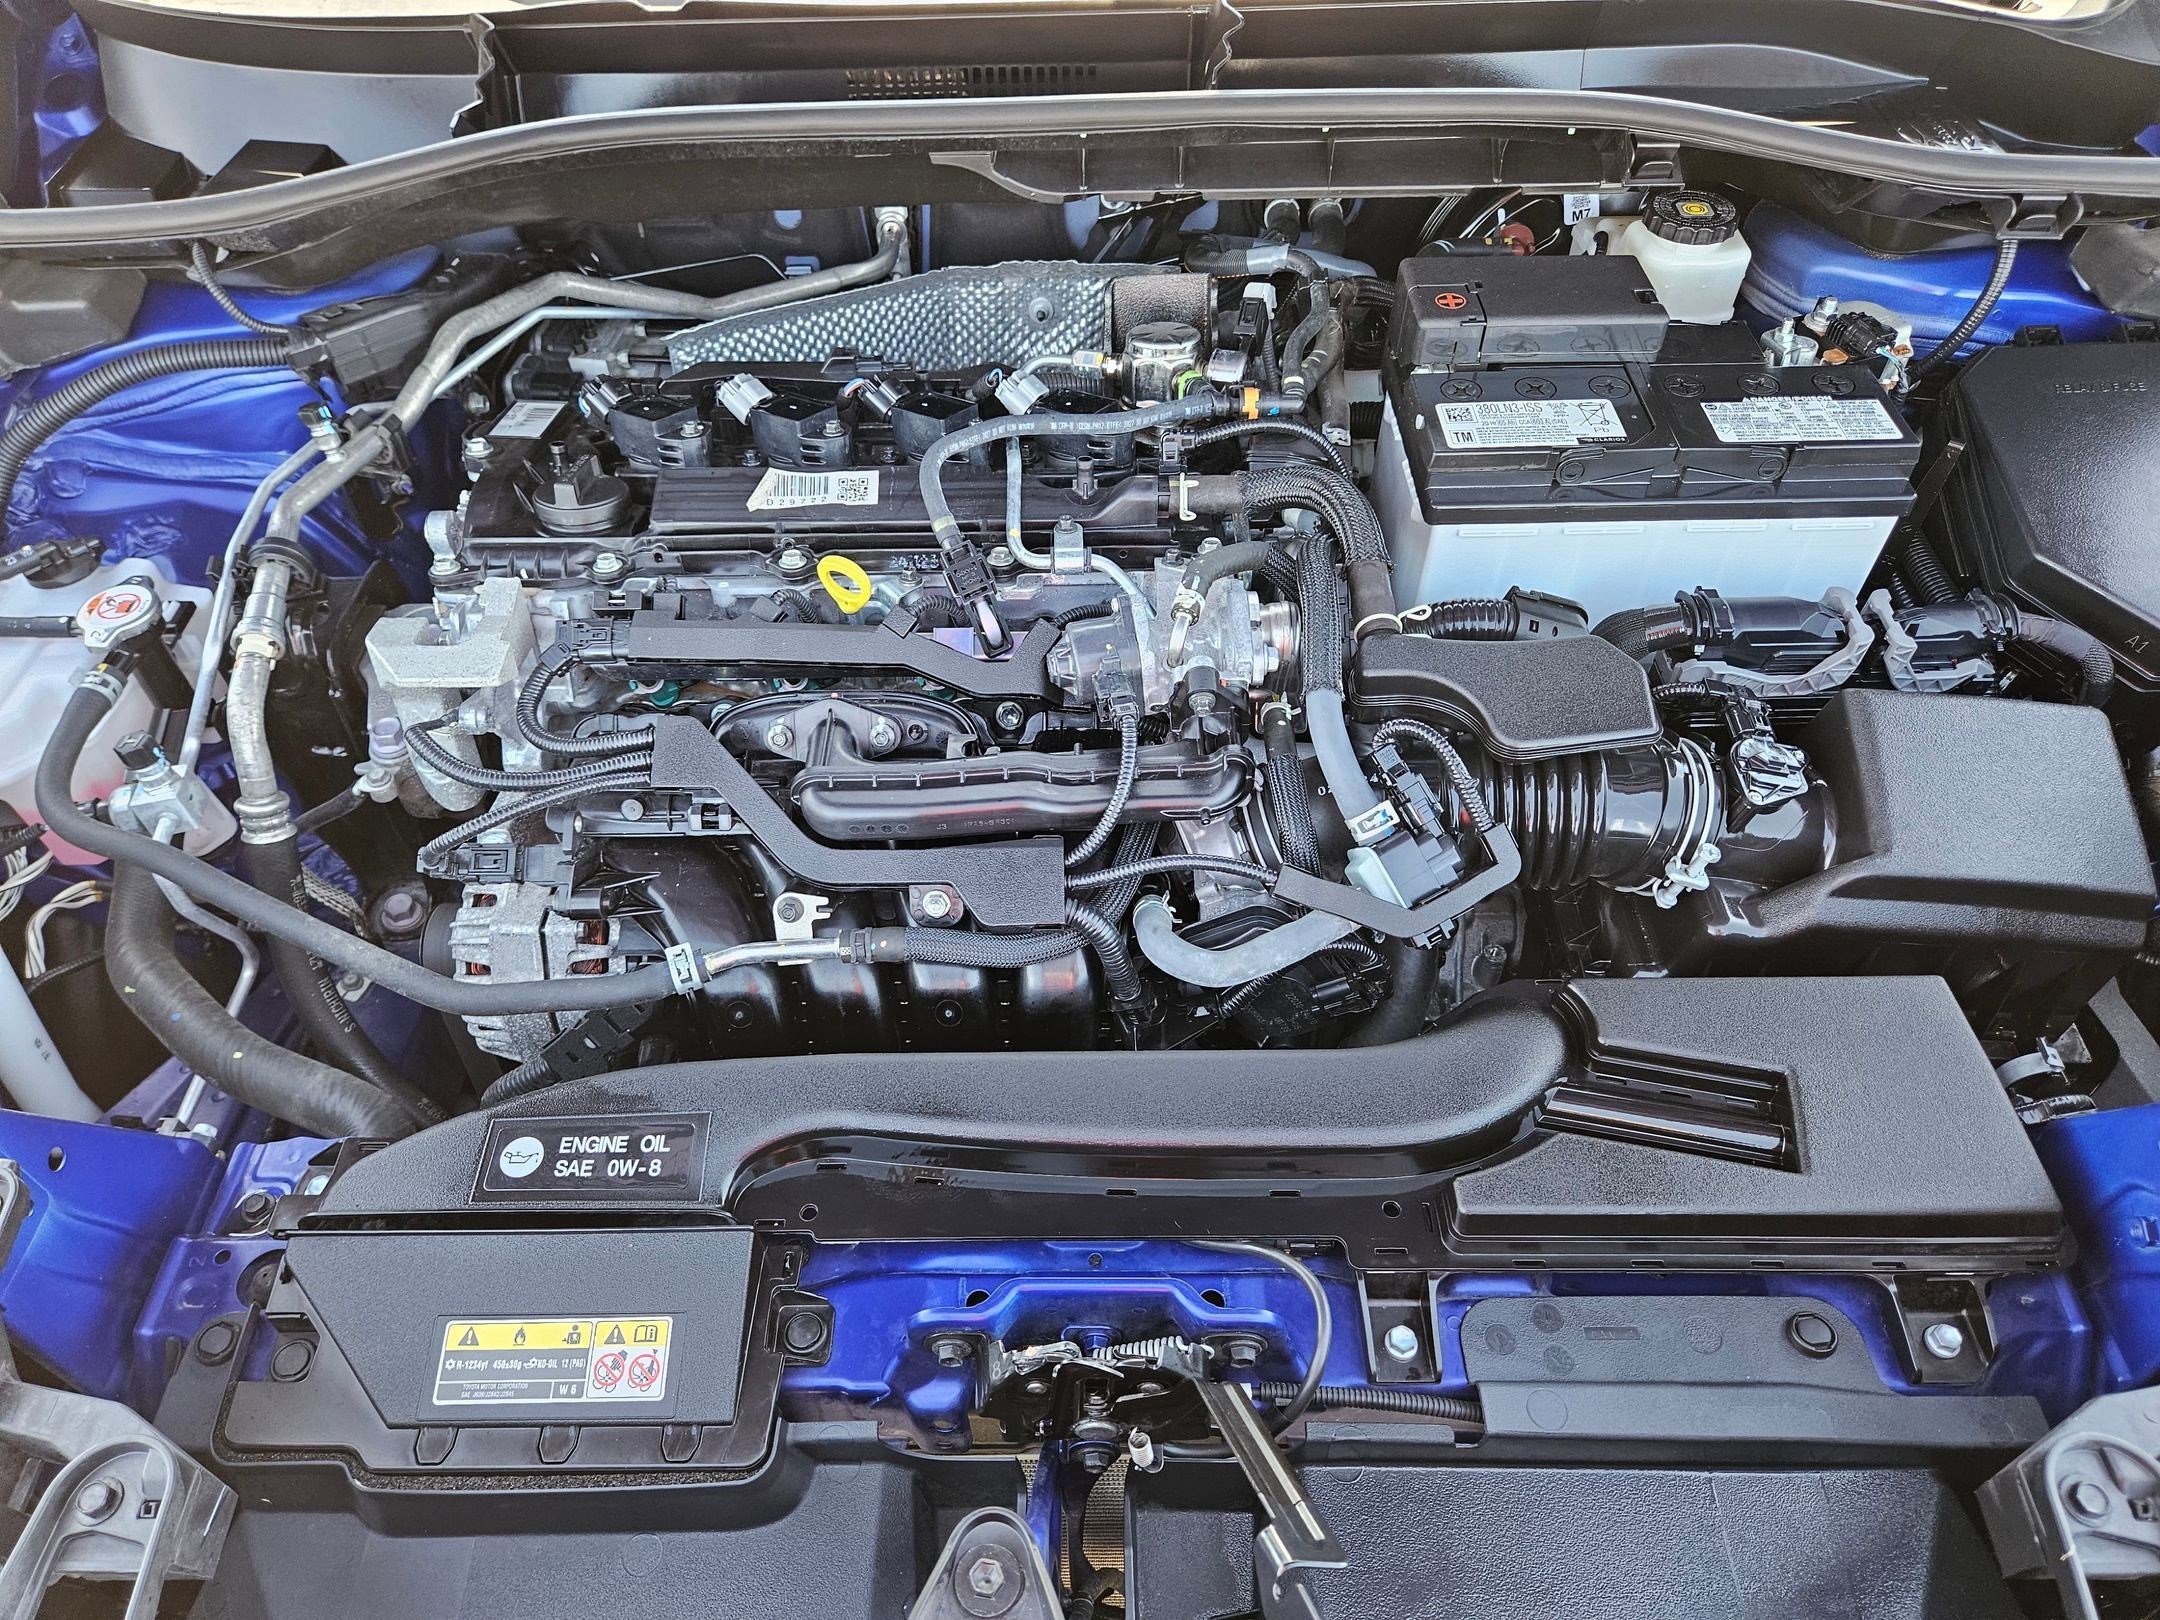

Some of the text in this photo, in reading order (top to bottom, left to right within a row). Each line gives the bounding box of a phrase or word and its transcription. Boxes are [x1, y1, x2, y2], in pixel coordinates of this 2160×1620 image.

[1572, 208, 1591, 222] M7
[1475, 402, 1543, 414] 380LN3-ISS
[1453, 432, 1474, 443] TM
[2125, 635, 2150, 654] A1
[558, 1134, 671, 1154] ENGINE OIL
[553, 1158, 662, 1177] SAE 0W-8
[456, 1360, 489, 1371] R-1234yf
